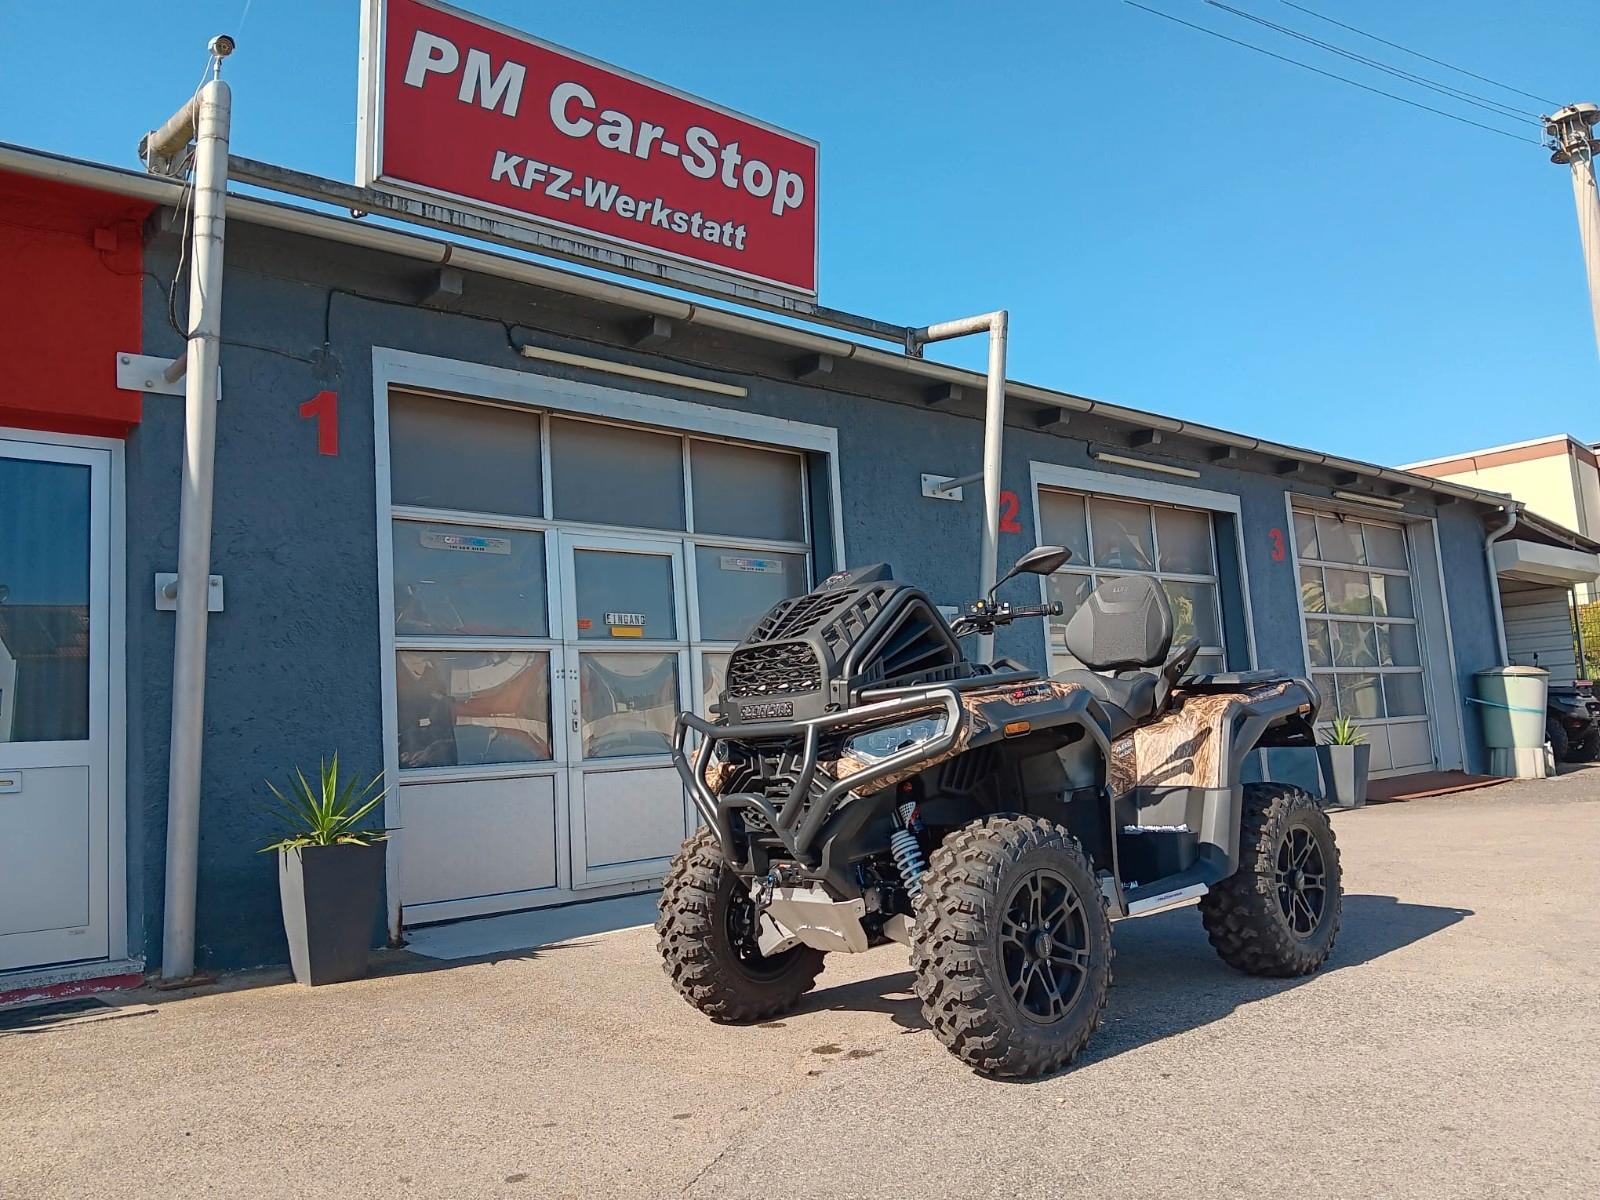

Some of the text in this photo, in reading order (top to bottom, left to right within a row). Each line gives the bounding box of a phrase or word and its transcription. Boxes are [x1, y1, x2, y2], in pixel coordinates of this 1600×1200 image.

[403, 29, 805, 217] PM Car-Stop
[489, 150, 748, 252] KFZ-Werkstatt
[299, 390, 338, 456] 1
[999, 490, 1021, 533] 2
[1268, 528, 1285, 562] 3
[605, 612, 646, 625] EINGANG
